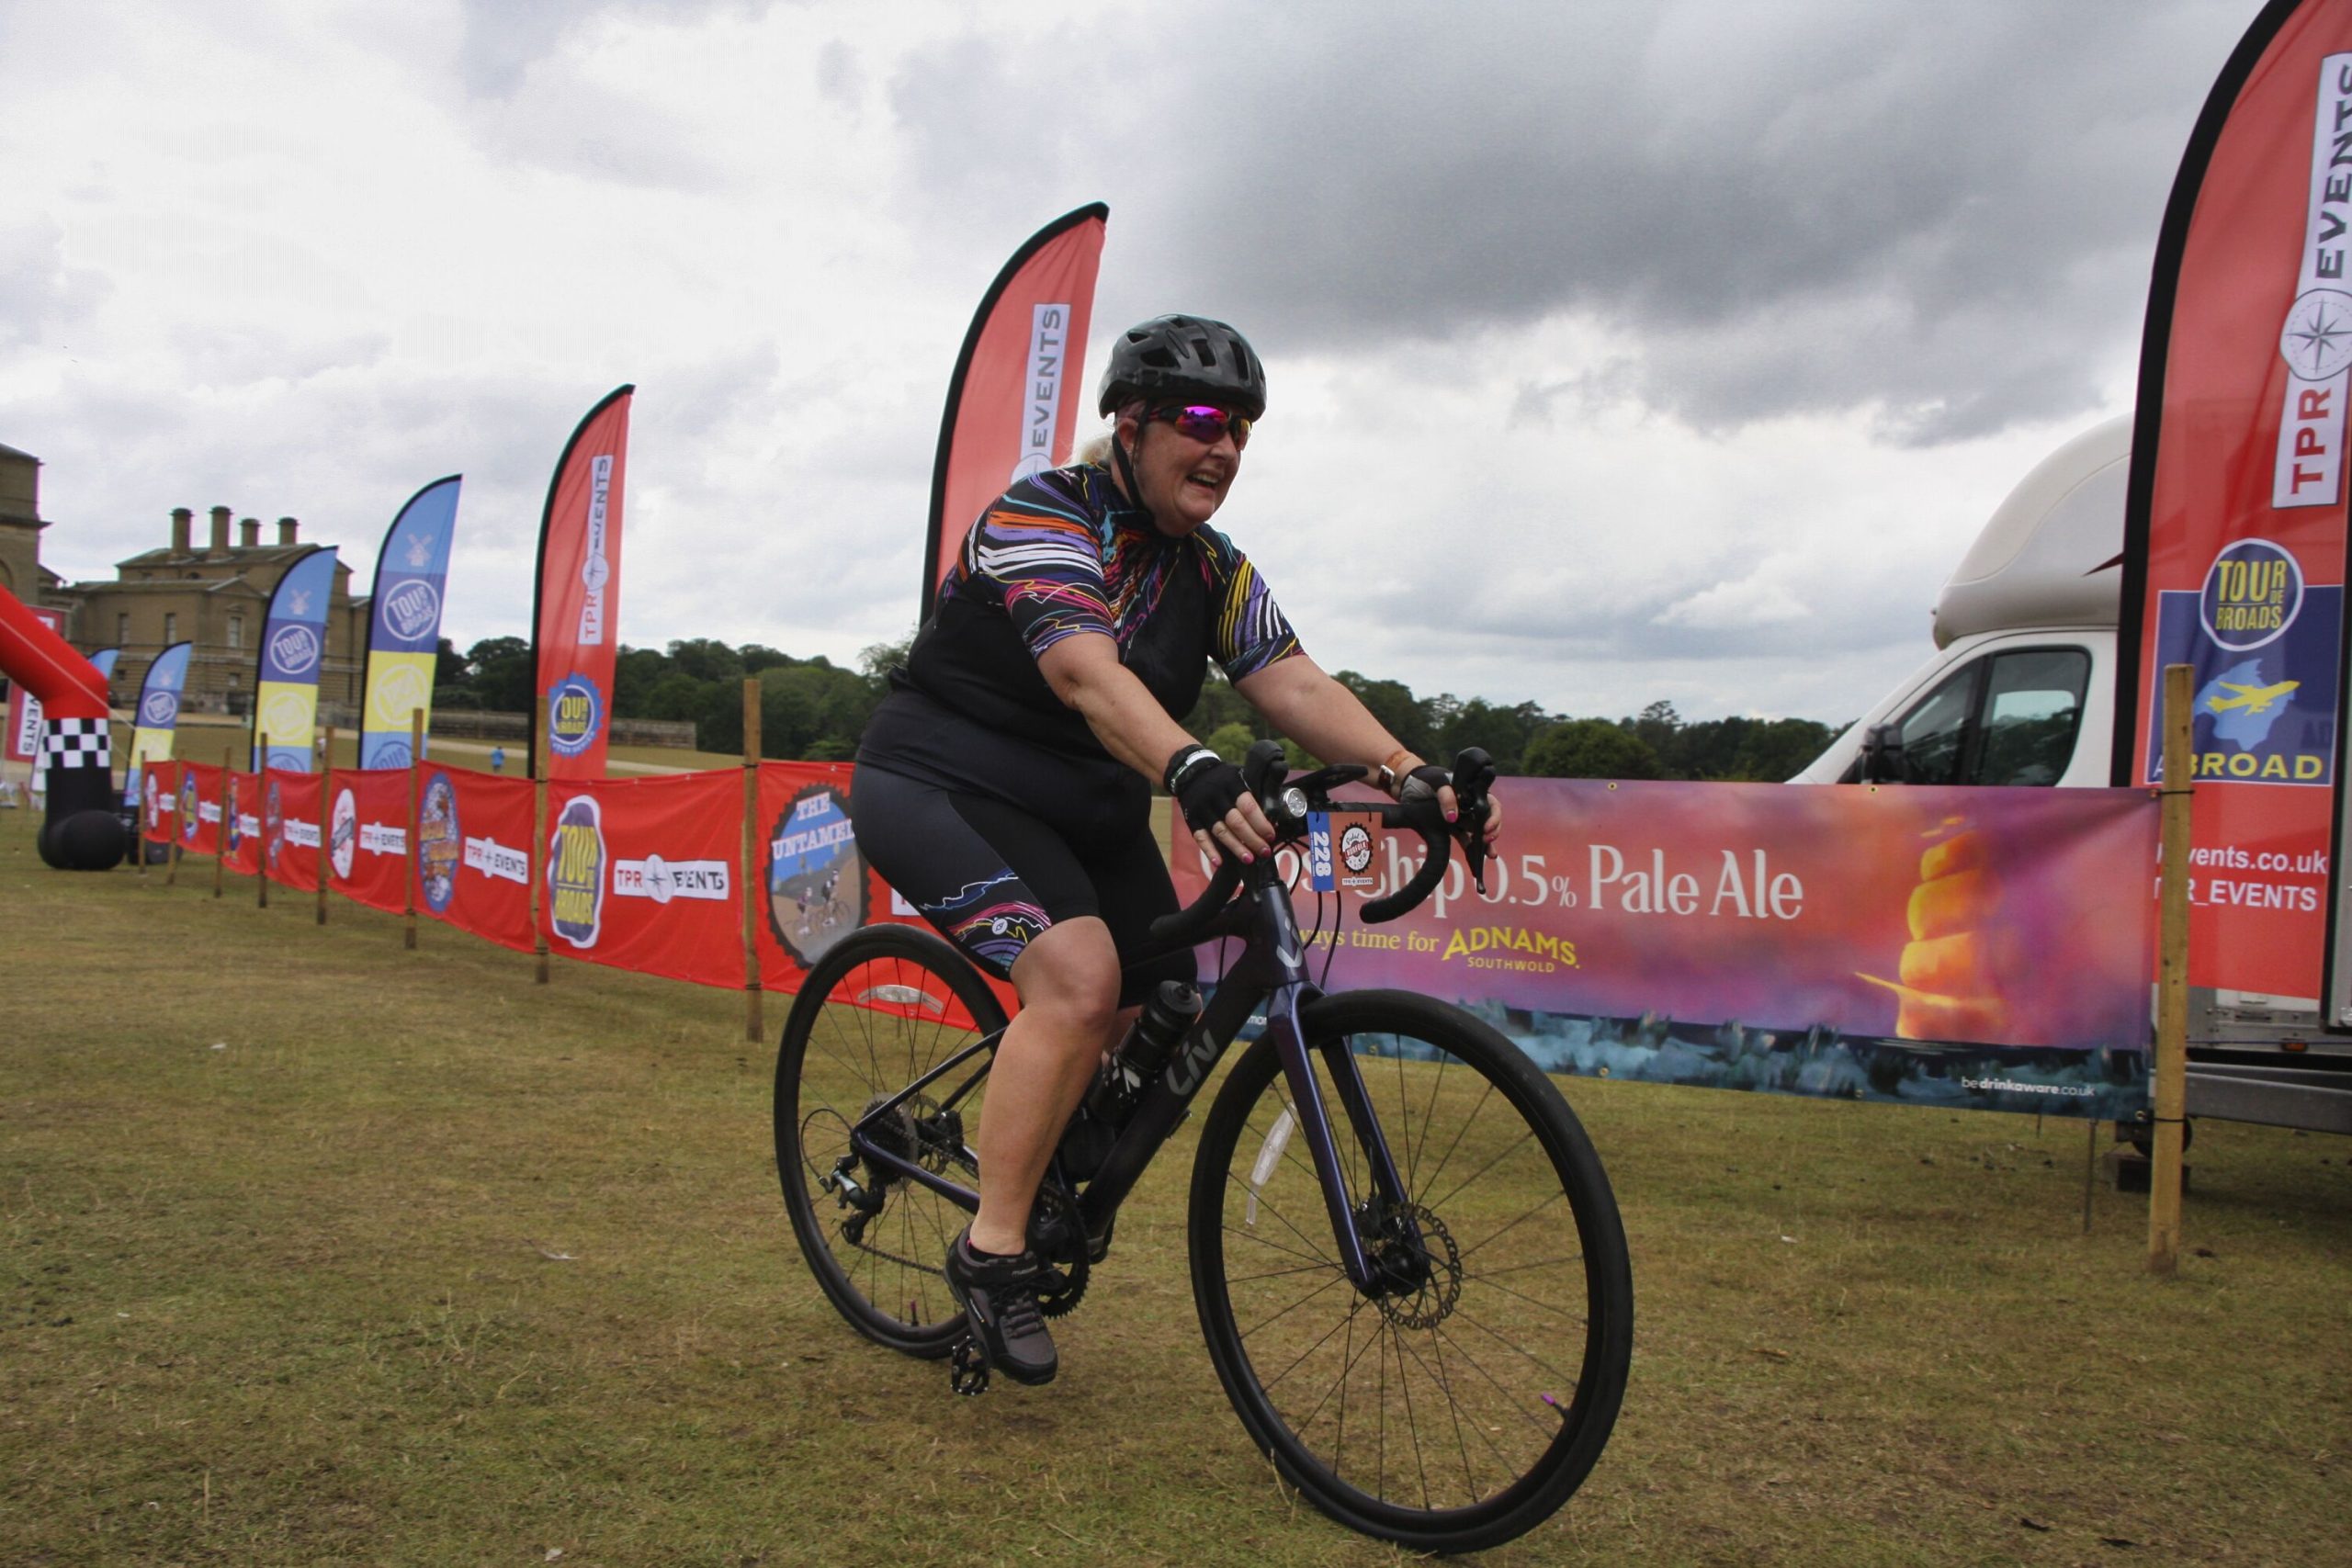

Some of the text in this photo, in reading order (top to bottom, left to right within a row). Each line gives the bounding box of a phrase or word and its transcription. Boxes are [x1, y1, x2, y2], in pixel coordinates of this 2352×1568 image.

[1031, 309, 1061, 448] EVENTS
[2290, 387, 2332, 495] TPR
[2217, 559, 2287, 603] TOUR
[2269, 589, 2285, 604] DE
[584, 593, 597, 638] TPR
[2214, 605, 2283, 631] BROADS
[22, 697, 40, 752] VENTS
[796, 791, 831, 821] THE
[1312, 831, 1332, 877] 228
[616, 869, 643, 888] TPR
[1588, 844, 1700, 916] Pale
[1709, 849, 1804, 919] Ale
[1352, 927, 1401, 950] time
[1407, 931, 1440, 953] for
[1467, 955, 1555, 974] SOUTHWOLD
[1961, 1076, 2096, 1098] bedrinkaware.co.uk
